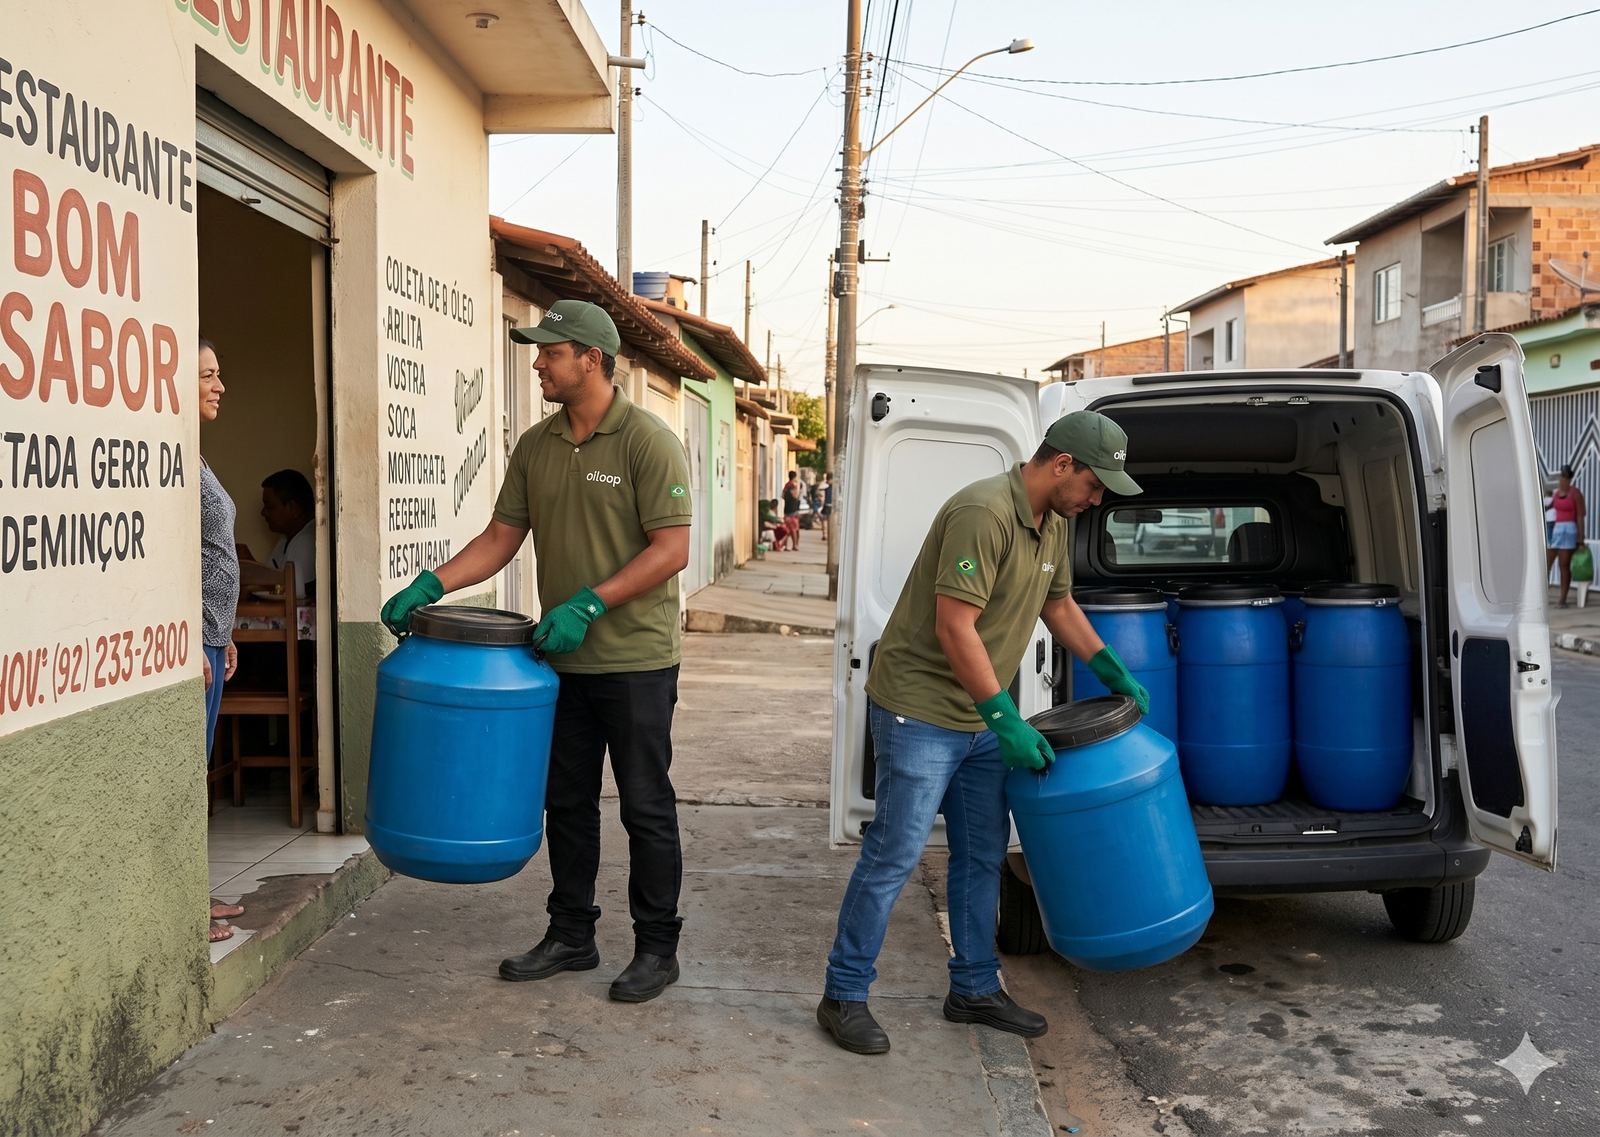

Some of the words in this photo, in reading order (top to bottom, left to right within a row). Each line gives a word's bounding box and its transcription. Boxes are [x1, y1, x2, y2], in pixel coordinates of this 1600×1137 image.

[13, 169, 140, 302] BOM
[386, 255, 425, 306] COLETA
[428, 276, 440, 313] DE
[450, 280, 474, 327] ÓLEO
[0, 291, 180, 415] SABOR
[386, 305, 423, 350] ARLITA
[386, 353, 426, 396] VOSTRA
[387, 403, 417, 440] SOCA
[0, 432, 78, 489] TADA
[91, 437, 150, 489] GERR
[160, 441, 184, 488] DA
[586, 470, 621, 488] oiloop
[2, 510, 145, 573] DEMINÇOR
[389, 497, 437, 532] REGERHIA
[53, 637, 90, 703] (92)
[94, 619, 189, 688] 233-2800
